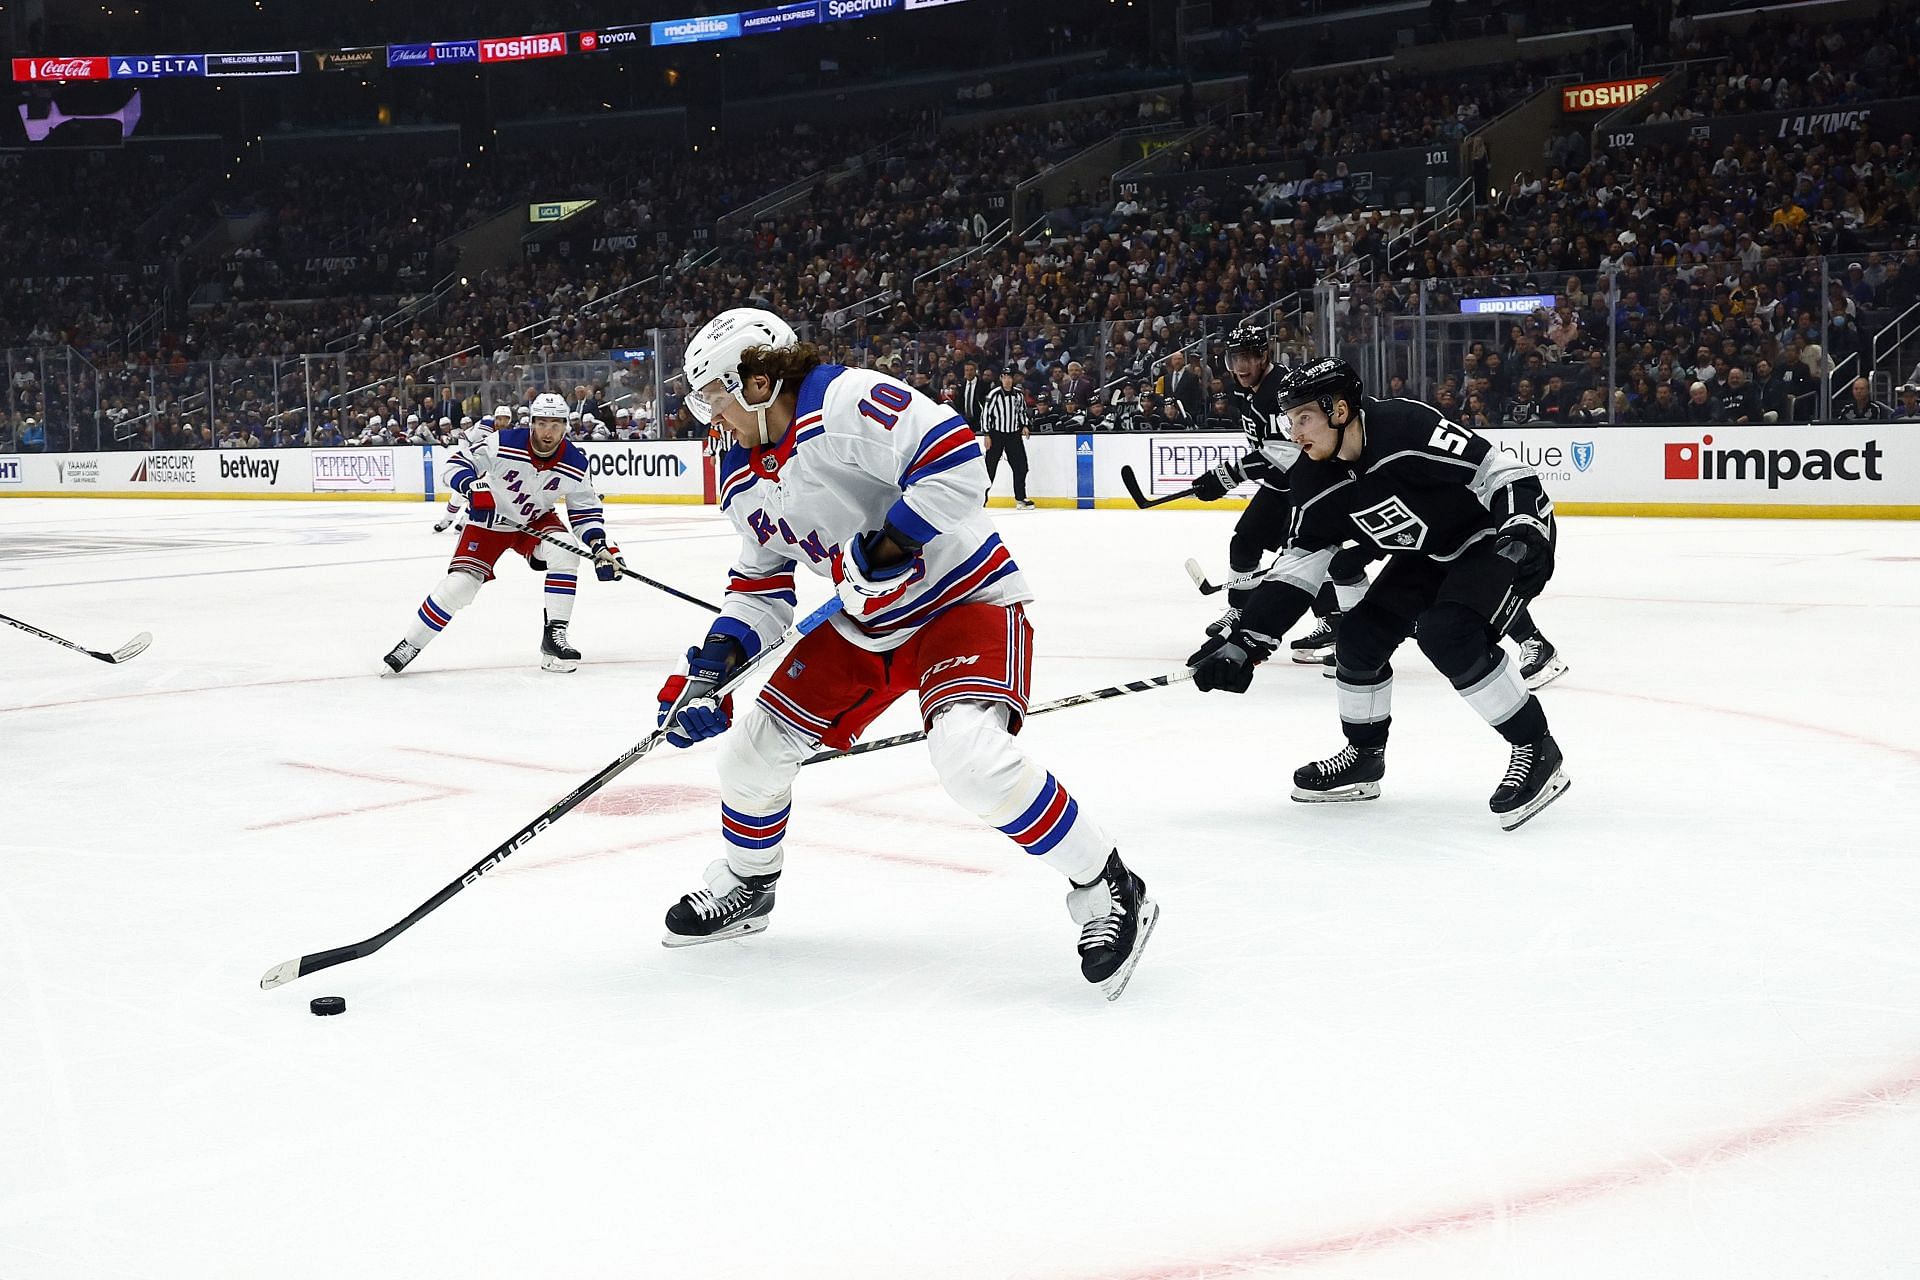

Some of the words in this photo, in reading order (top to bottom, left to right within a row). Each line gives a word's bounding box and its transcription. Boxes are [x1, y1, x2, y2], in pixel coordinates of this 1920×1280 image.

[744, 14, 782, 28] AMERICAN
[782, 9, 816, 22] EXPRESS
[664, 20, 728, 37] mobilitie
[598, 31, 636, 44] TOYOTA
[436, 47, 476, 59] ULTRA
[484, 37, 562, 58] TOSHIBA
[137, 60, 199, 73] DELTA
[221, 56, 257, 64] WELCOME
[1607, 132, 1636, 148] 102
[1425, 151, 1449, 166] 101
[1119, 182, 1139, 196] 101
[541, 207, 560, 216] UCLA
[1479, 302, 1505, 312] BUD
[1505, 300, 1541, 312] LIGHT
[858, 382, 913, 431] 10
[148, 455, 195, 470] MERCURY
[589, 447, 679, 481] pectrum
[1703, 434, 1883, 489] impact
[148, 471, 197, 483] INSURANCE
[219, 454, 280, 486] betway
[315, 456, 392, 485] PEPPERDINE
[543, 476, 561, 491] A
[502, 470, 542, 523] RANGE
[920, 654, 980, 687] CCM
[461, 816, 551, 888] BAUER
[722, 903, 753, 926] CCM
